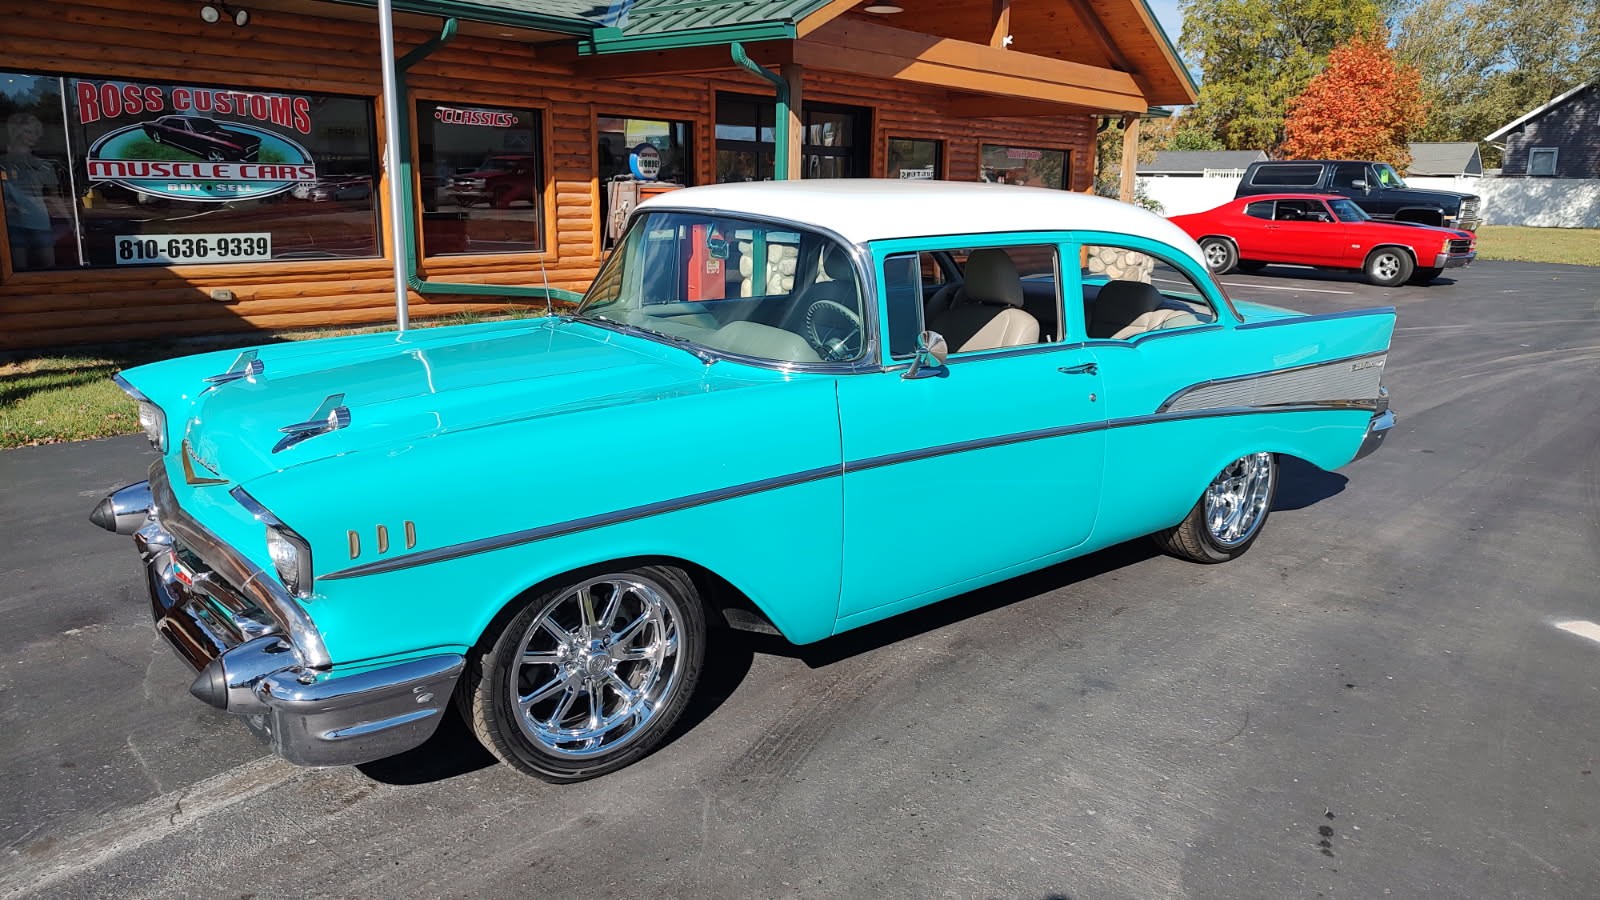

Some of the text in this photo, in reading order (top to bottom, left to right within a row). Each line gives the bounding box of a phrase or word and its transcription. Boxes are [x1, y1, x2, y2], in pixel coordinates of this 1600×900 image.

[76, 81, 312, 135] ROSS CUSTOMS
[441, 109, 512, 127] CLASSICS
[88, 161, 315, 180] MUSCLE CARS
[167, 183, 253, 192] BUY SELL
[119, 237, 268, 260] 810-636-9339
